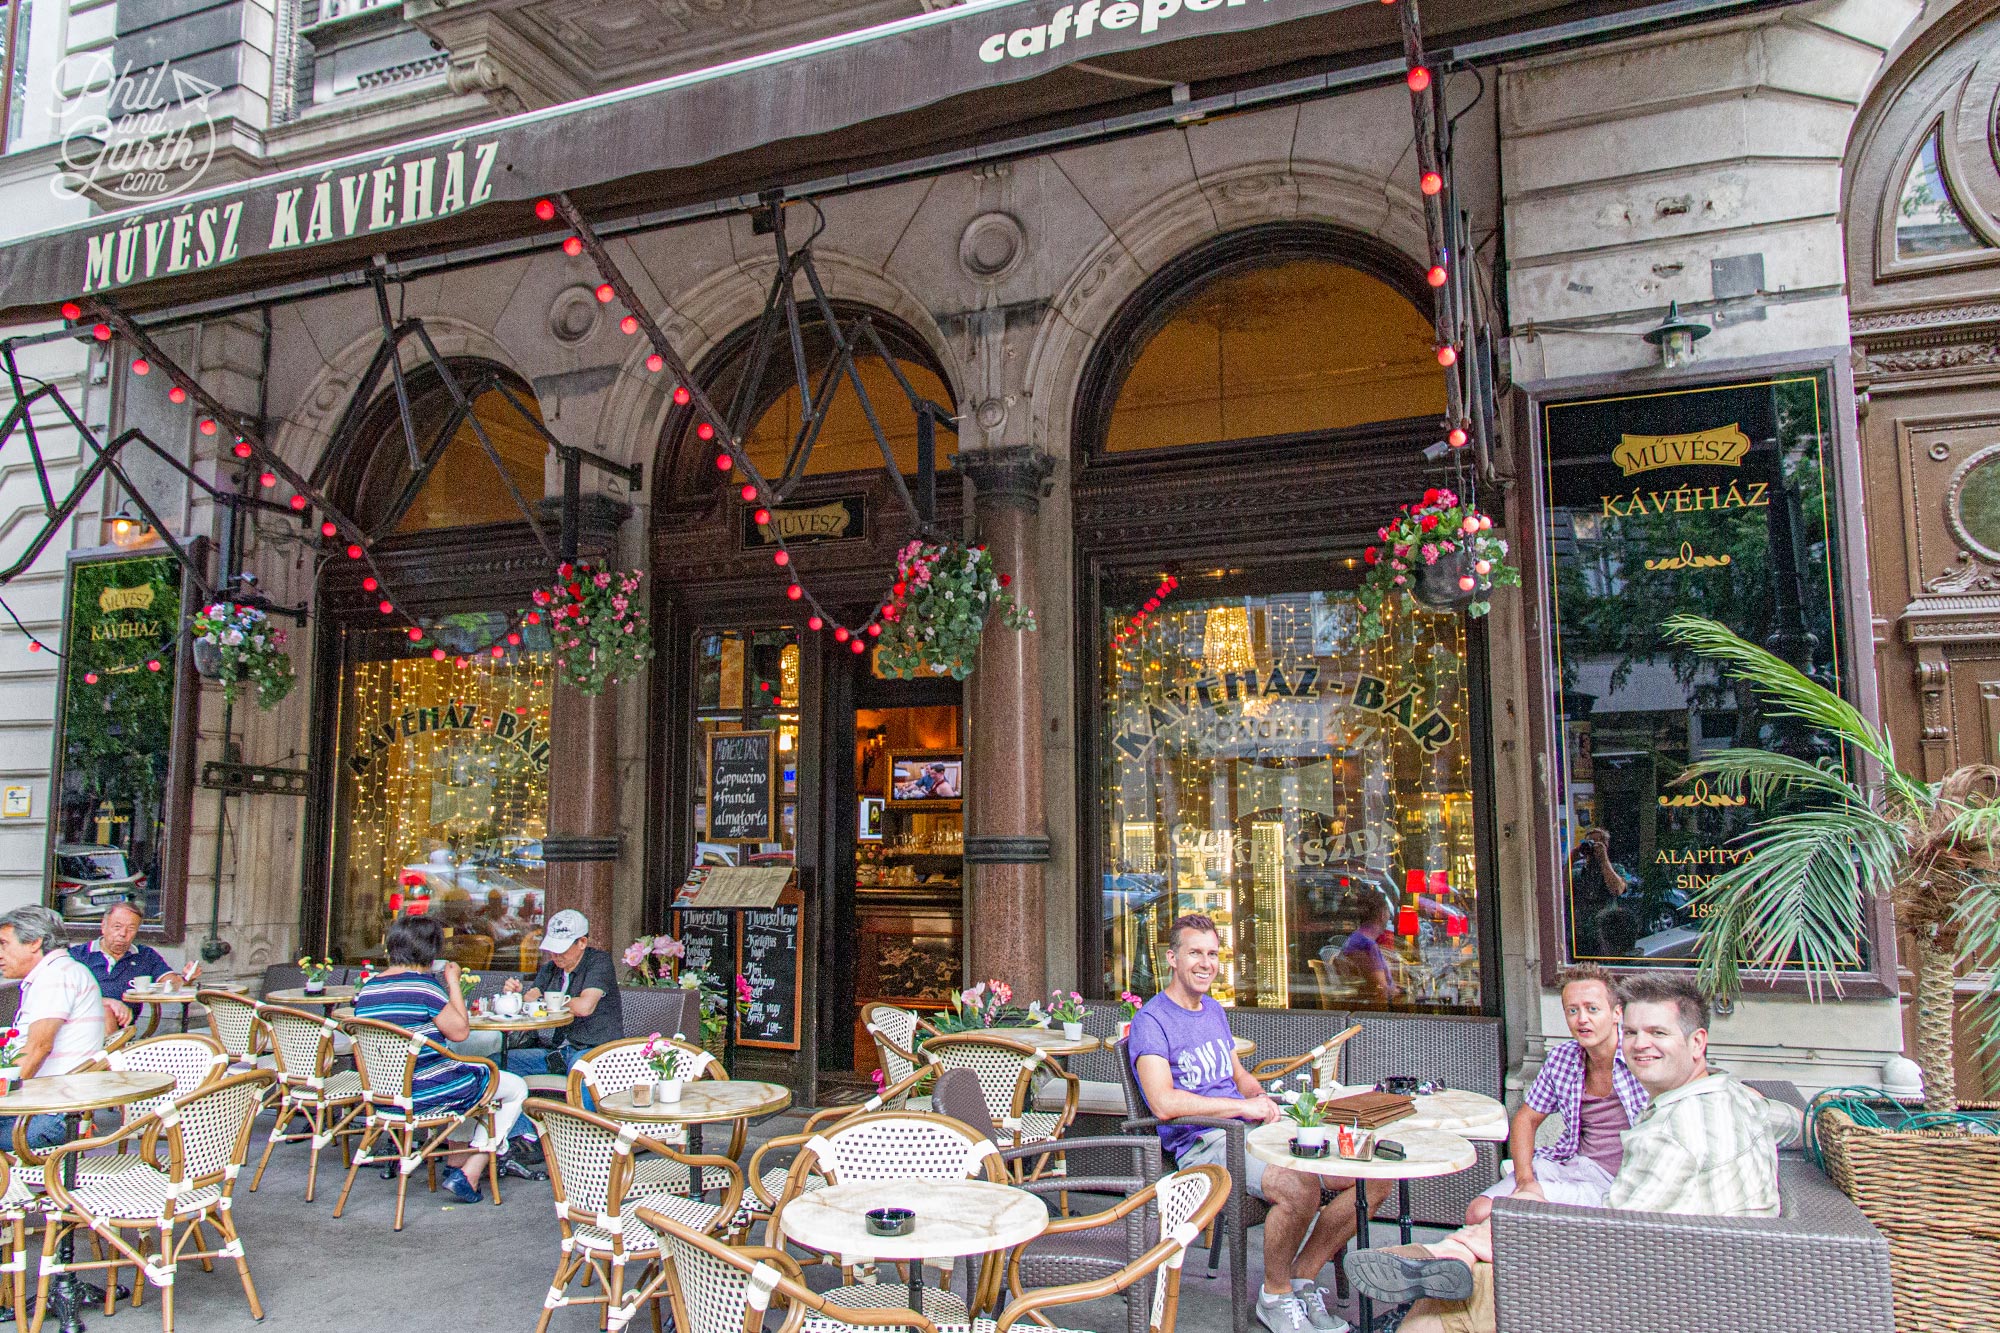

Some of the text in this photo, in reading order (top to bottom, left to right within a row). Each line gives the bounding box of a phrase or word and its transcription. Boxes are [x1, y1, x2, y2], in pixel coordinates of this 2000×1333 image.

[82, 139, 500, 293] MŰVÉSZ KÁVÉHÁZ
[1624, 435, 1737, 472] MŰVÉSZ
[1600, 478, 1771, 518] KÁVÉHÁZ
[715, 766, 767, 788] Cappuccino
[714, 808, 768, 826] almatorta
[1689, 903, 1728, 918] 189
